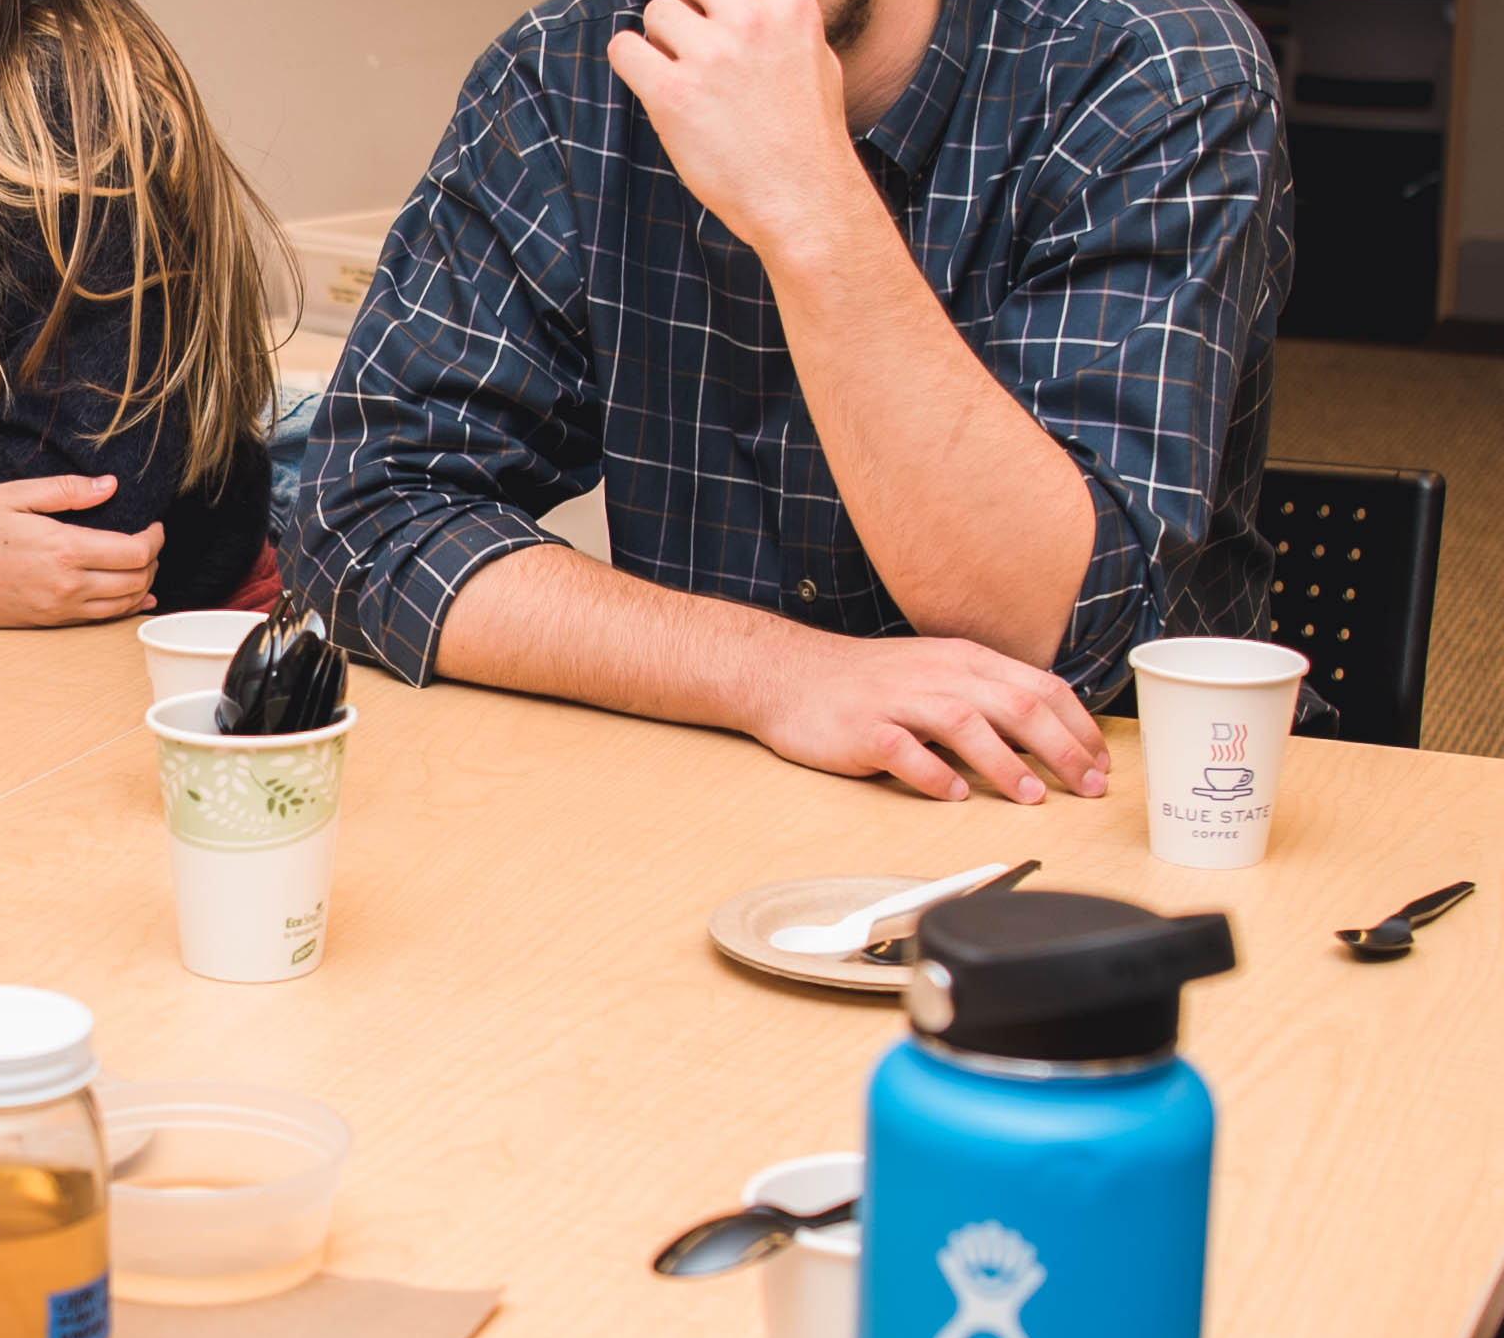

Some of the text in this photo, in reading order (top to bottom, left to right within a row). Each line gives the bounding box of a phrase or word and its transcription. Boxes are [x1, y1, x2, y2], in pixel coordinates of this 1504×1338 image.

[1162, 803, 1271, 824] BLUE STATE
[1192, 830, 1240, 839] COFFEE
